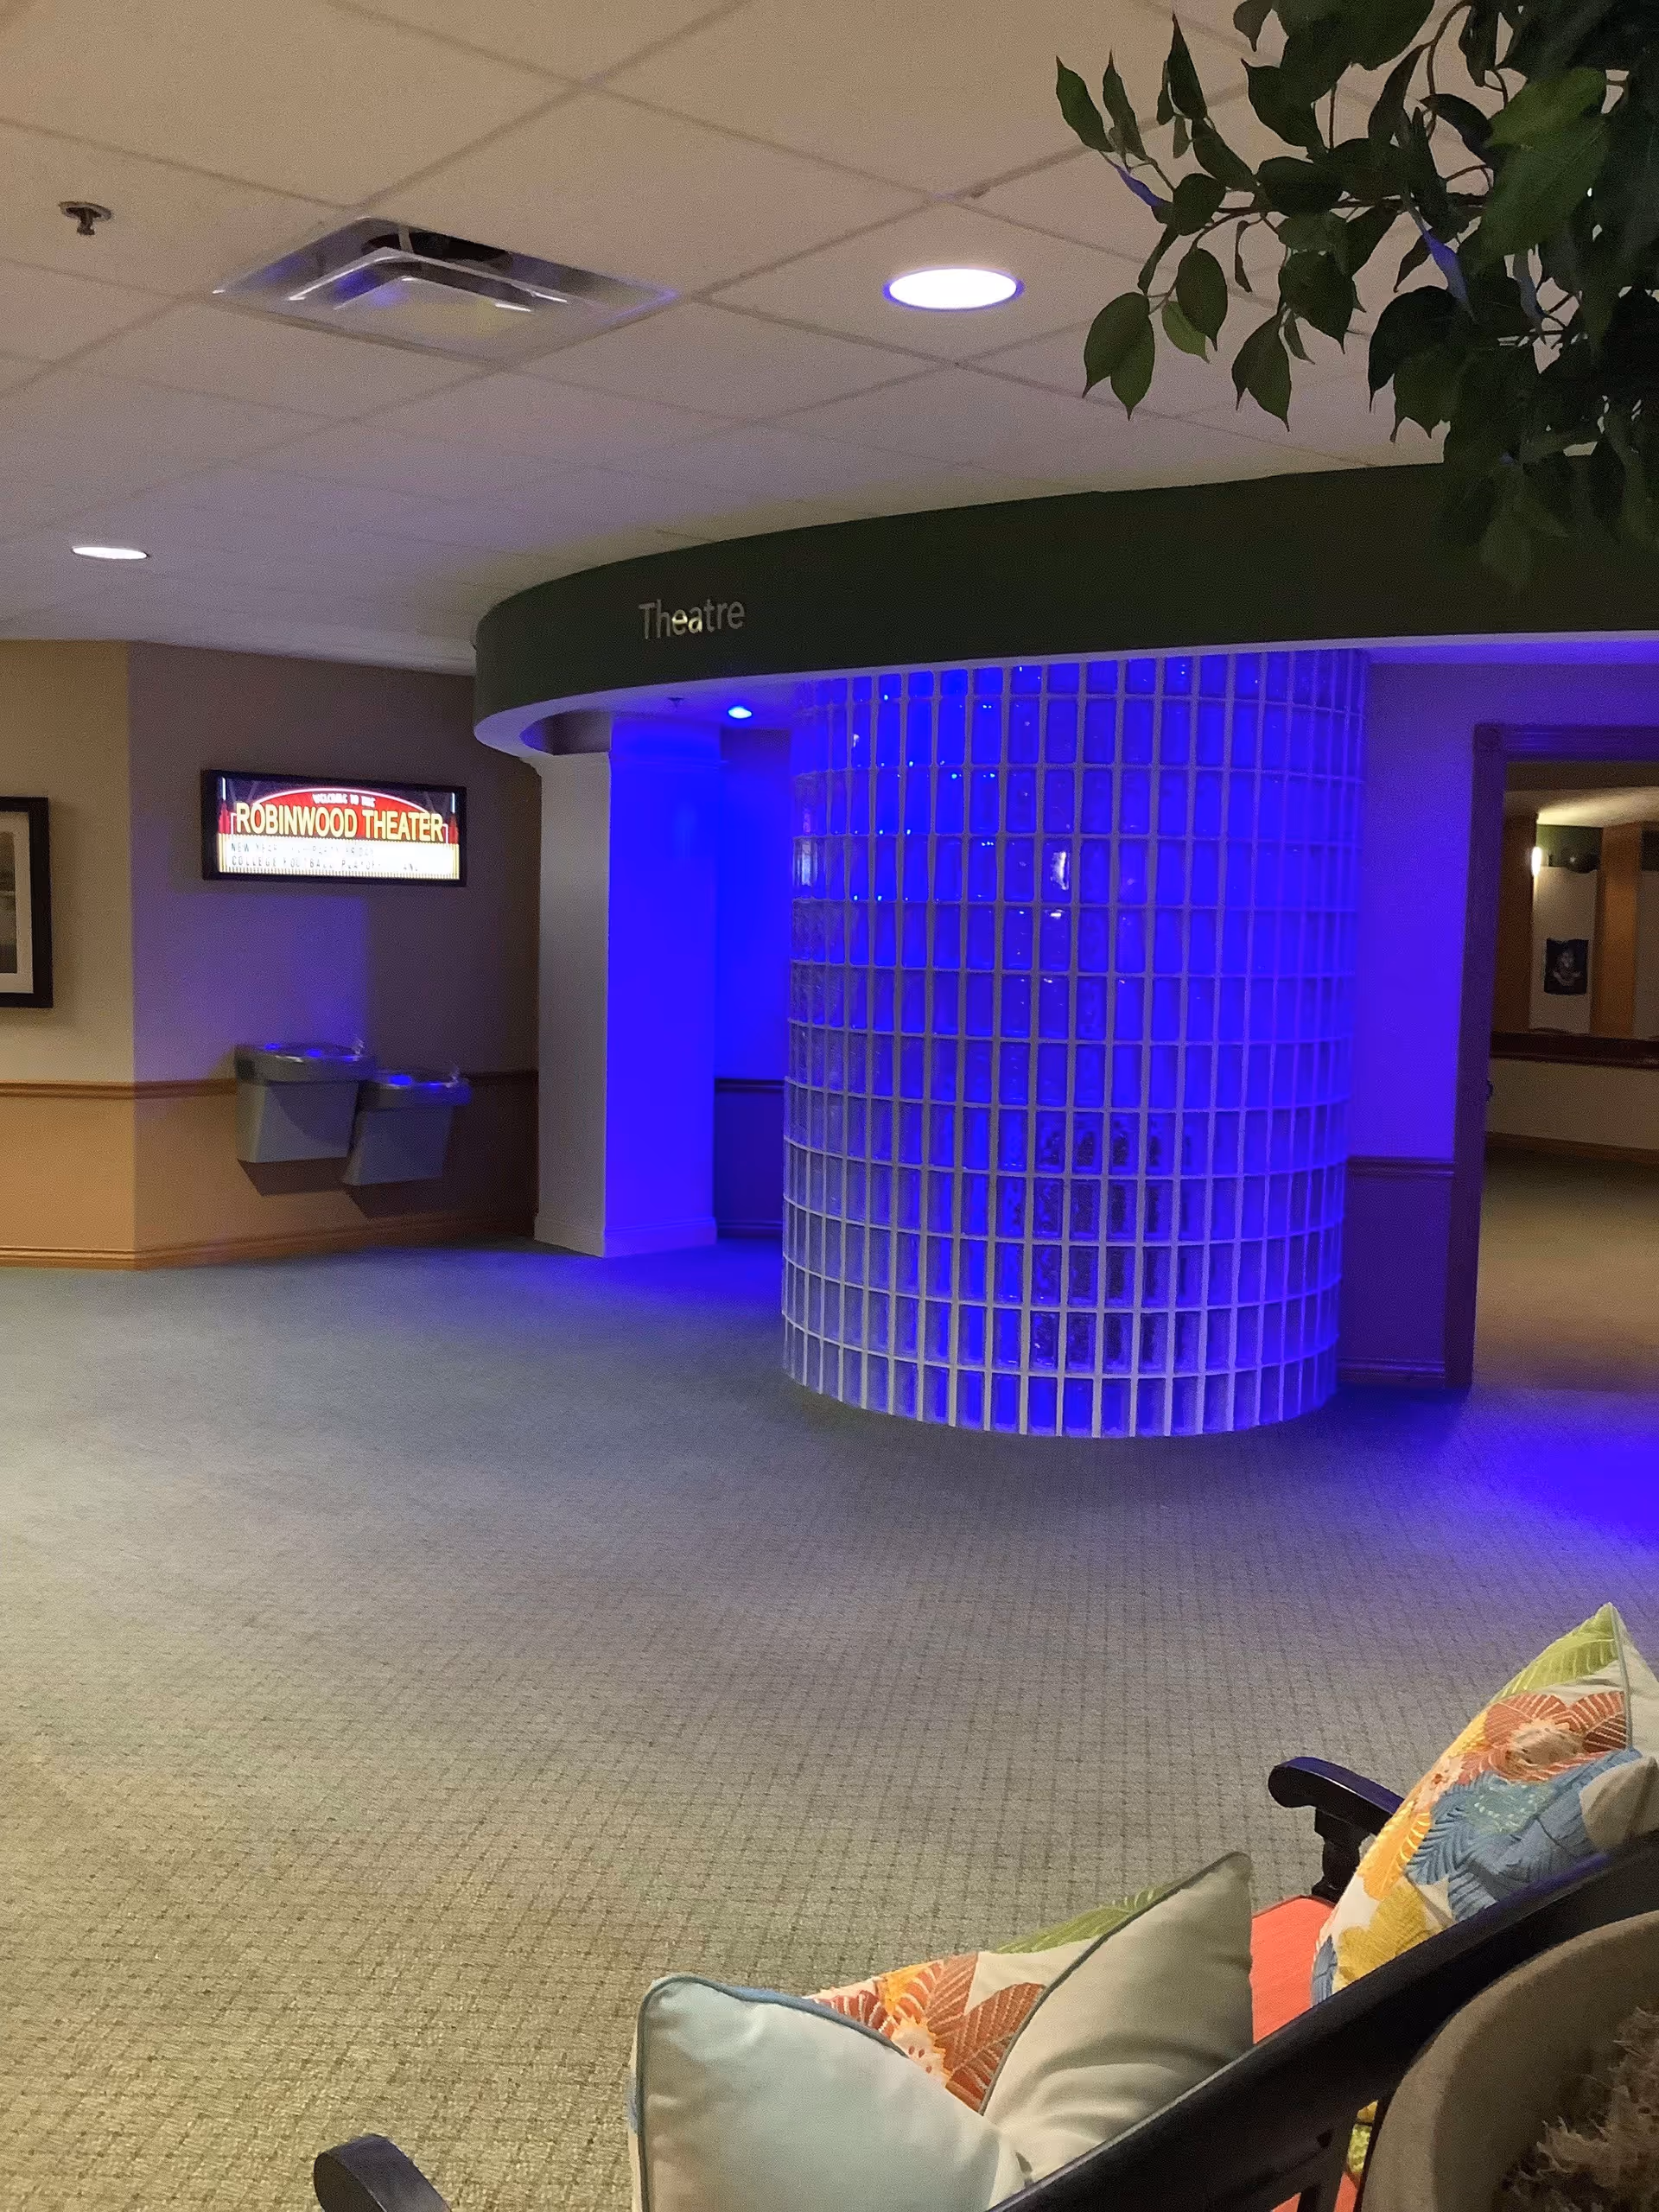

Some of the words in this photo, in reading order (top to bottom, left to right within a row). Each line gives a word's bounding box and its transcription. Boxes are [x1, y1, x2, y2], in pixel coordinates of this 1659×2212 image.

[638, 599, 746, 640] Theatre
[236, 802, 358, 839] ROBINWOOD
[361, 808, 444, 842] THEATER
